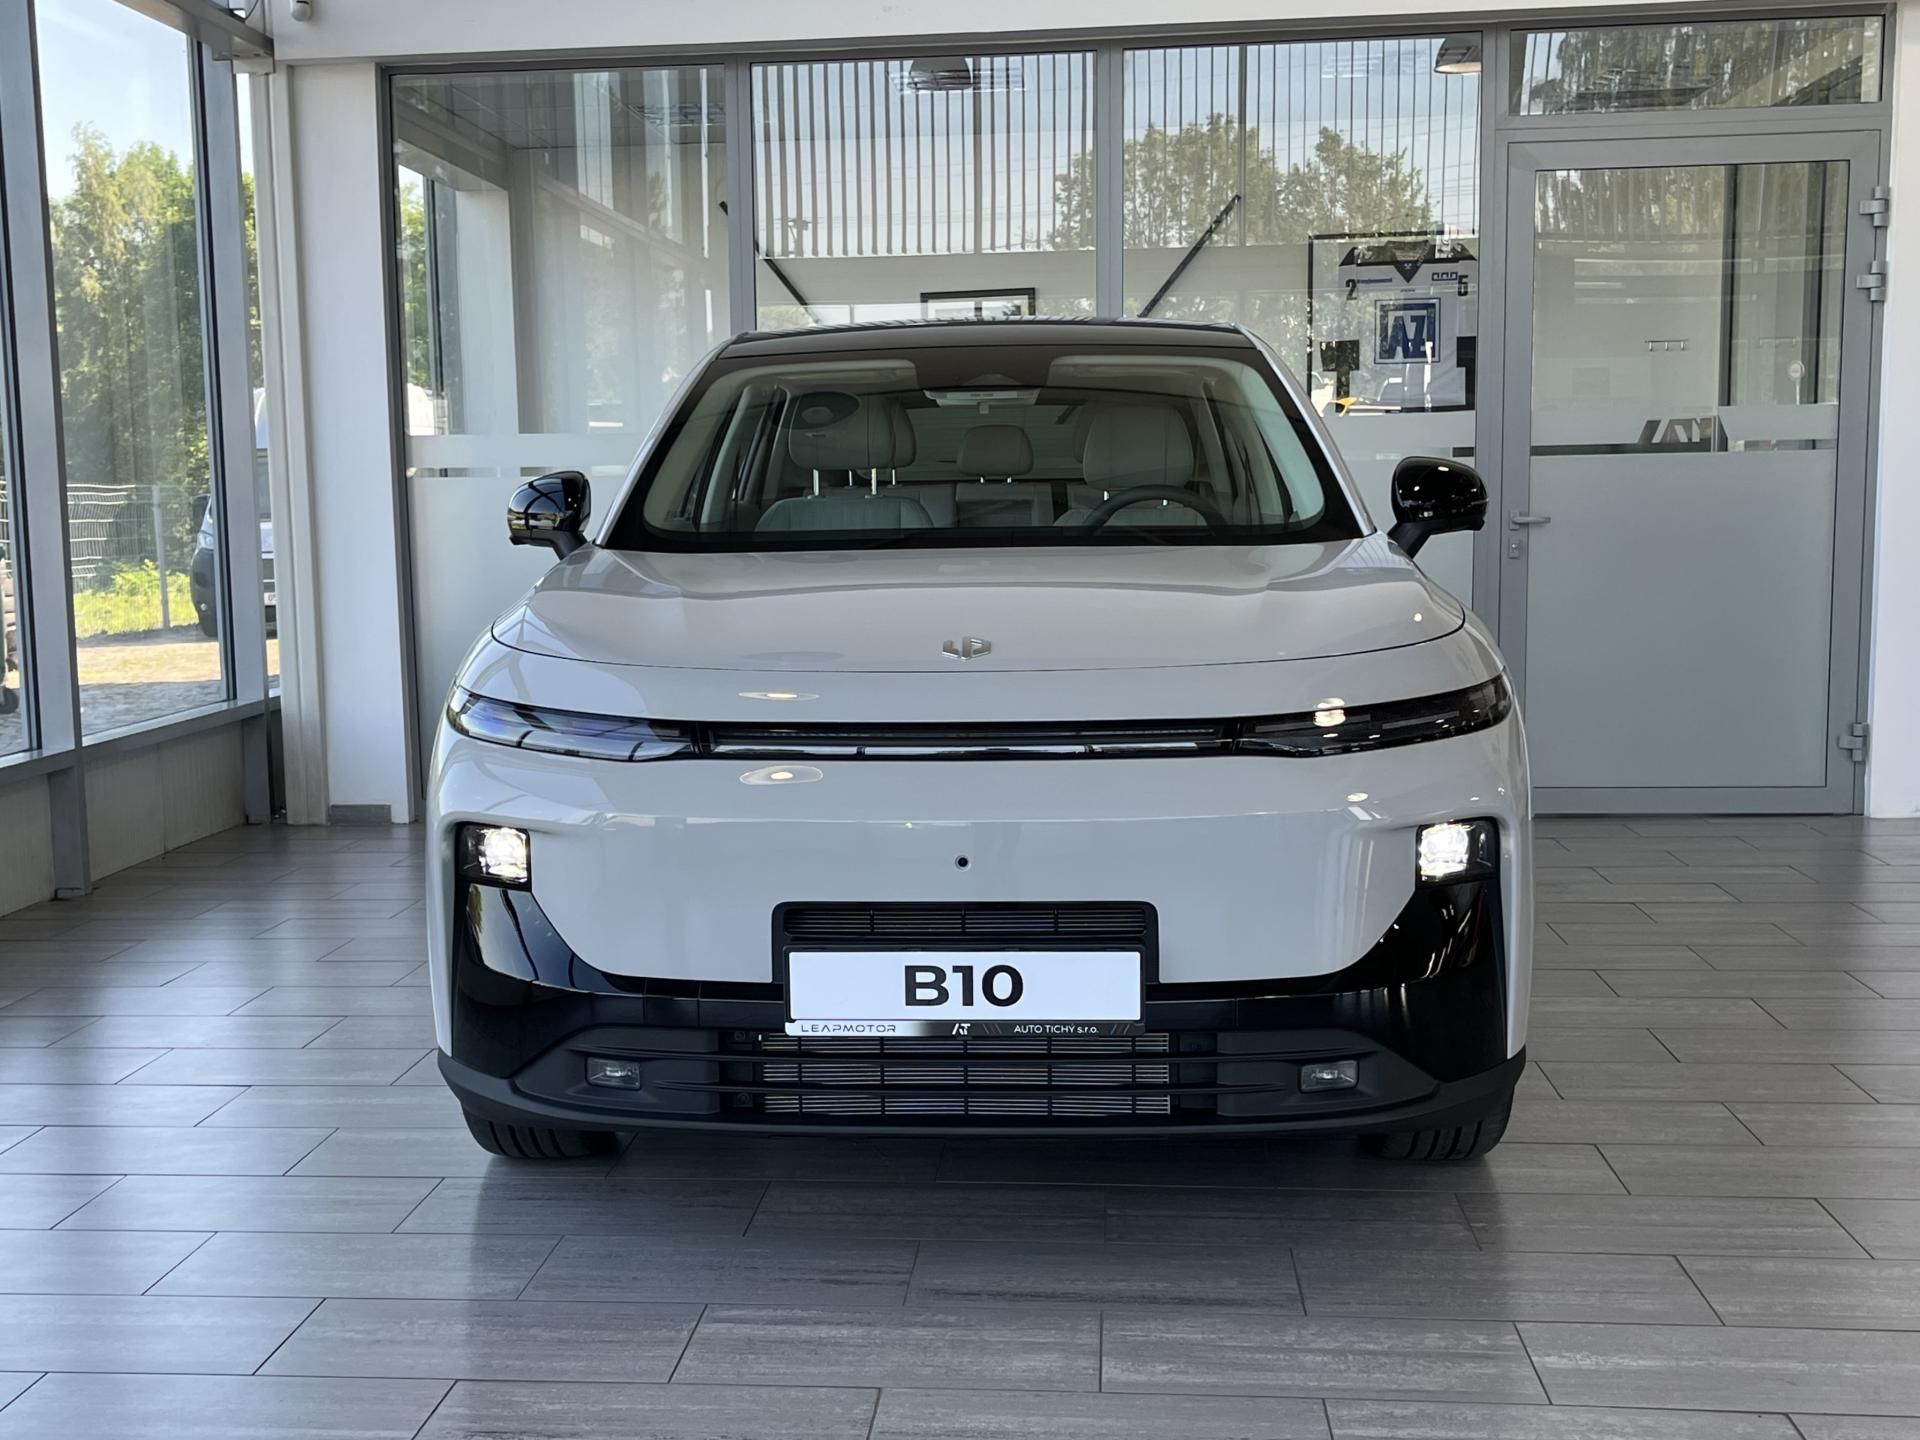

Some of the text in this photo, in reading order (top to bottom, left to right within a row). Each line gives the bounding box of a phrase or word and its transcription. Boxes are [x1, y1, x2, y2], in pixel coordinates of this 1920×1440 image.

[1345, 278, 1357, 300] 2
[904, 964, 1024, 1007] B10
[801, 1024, 896, 1033] LEAPMOTOR
[1014, 1025, 1043, 1034] AUTO
